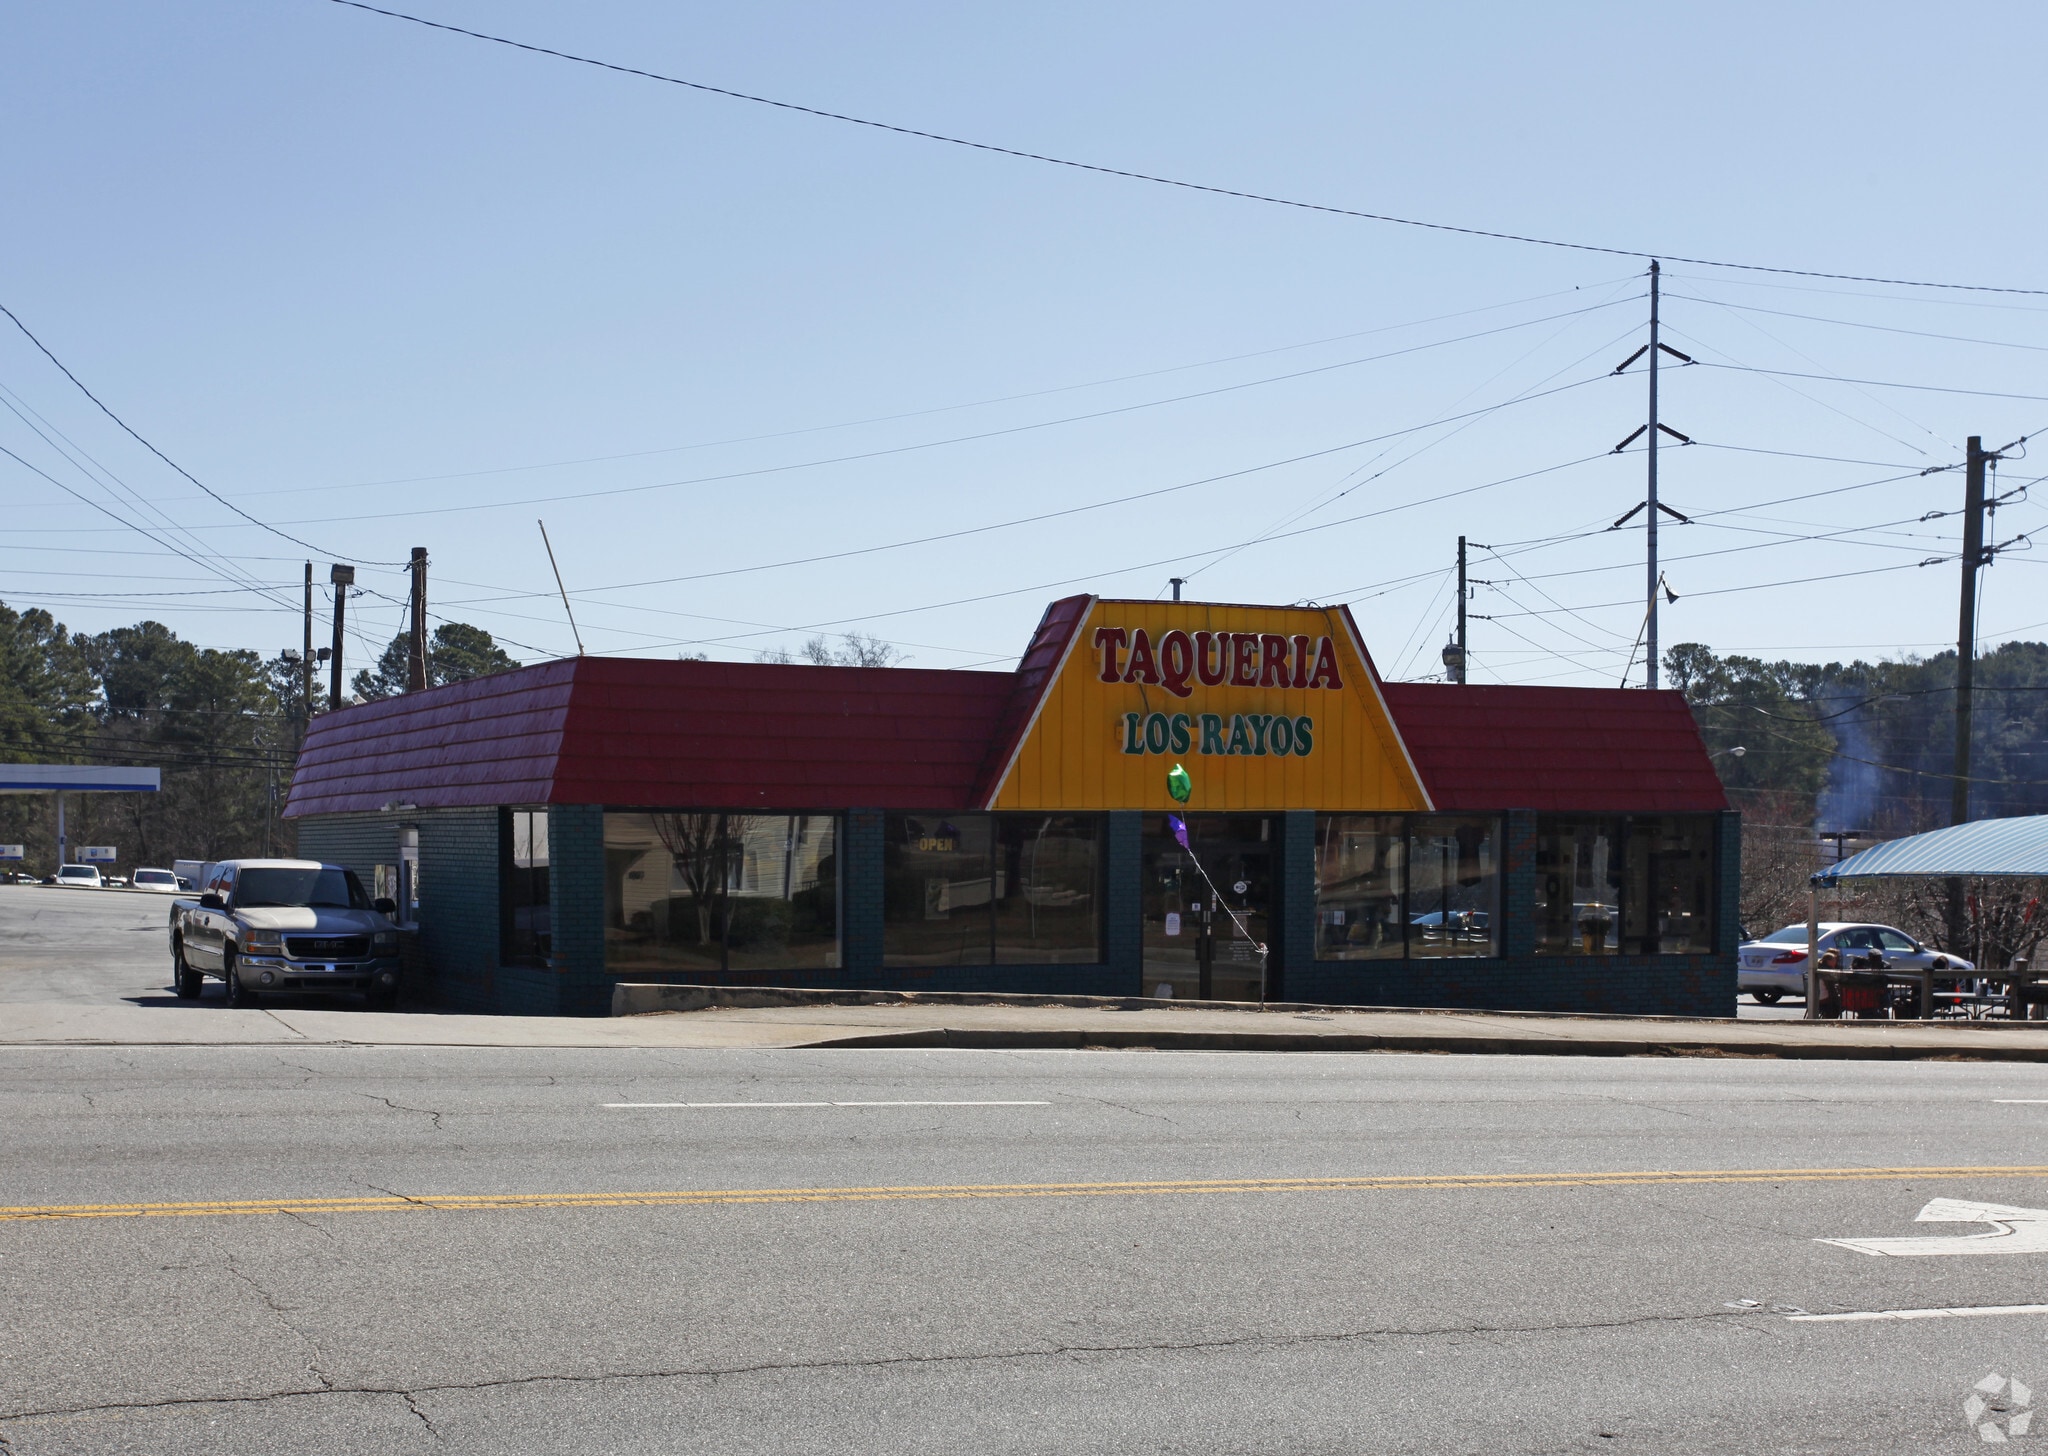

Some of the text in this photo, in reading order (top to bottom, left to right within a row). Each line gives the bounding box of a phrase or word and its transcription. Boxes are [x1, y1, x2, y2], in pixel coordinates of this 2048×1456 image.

[1093, 627, 1343, 698] TAQUERIA
[1122, 712, 1313, 757] LOS RAYOS
[919, 837, 953, 852] OPEN
[314, 940, 345, 950] GMC
